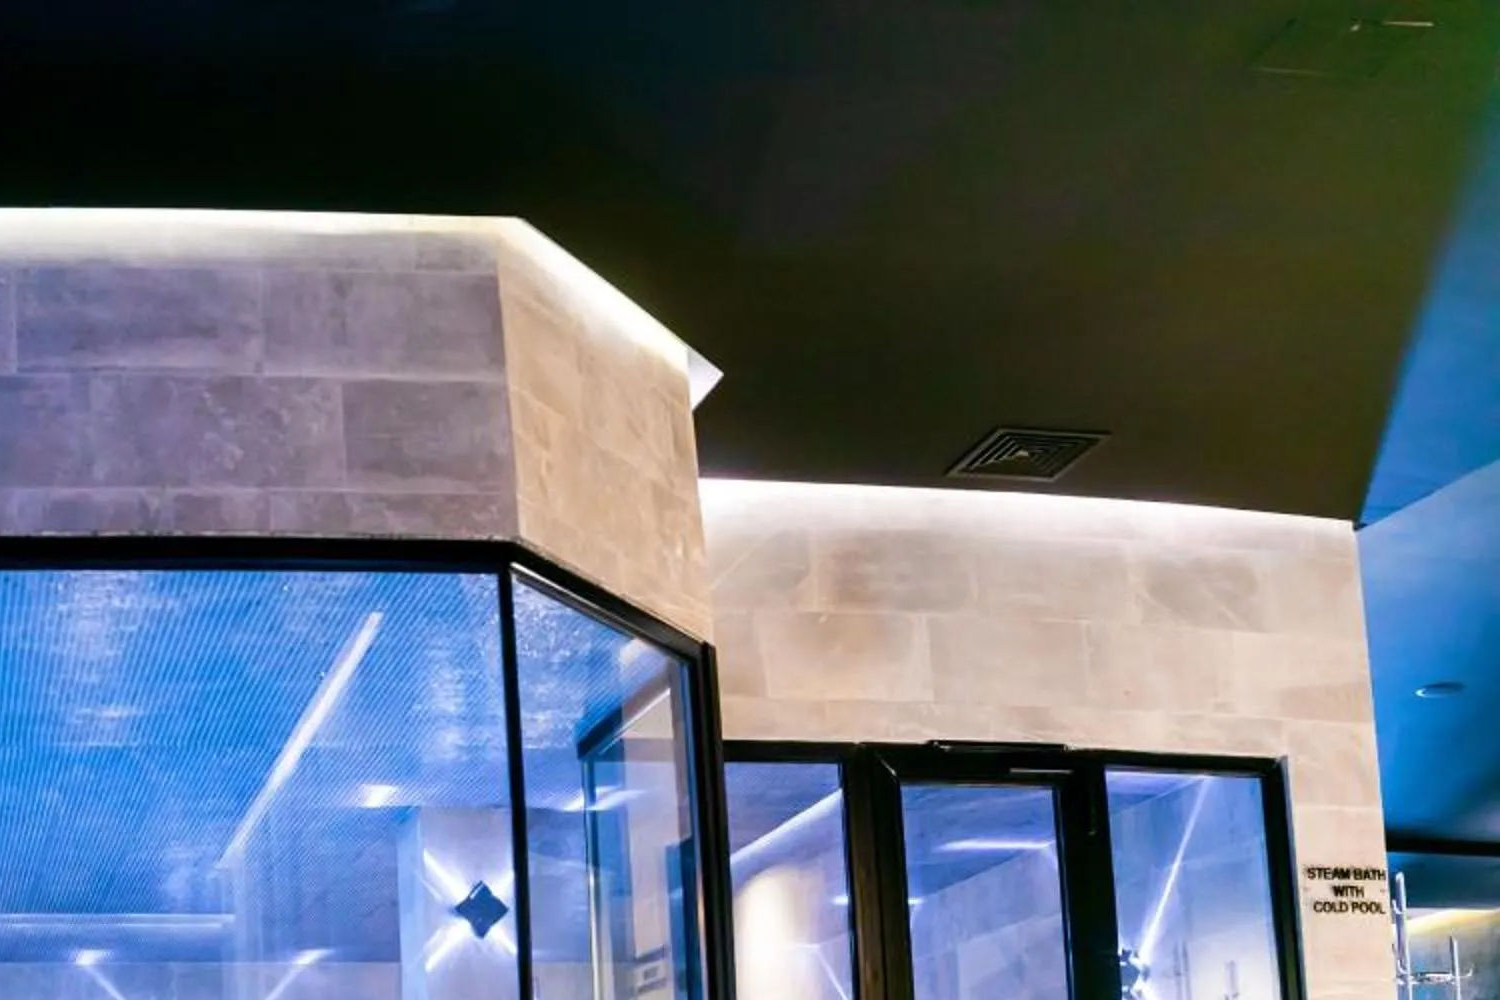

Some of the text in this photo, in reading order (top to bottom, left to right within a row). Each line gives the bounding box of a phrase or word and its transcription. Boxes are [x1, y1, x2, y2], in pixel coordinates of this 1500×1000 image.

[1307, 867, 1386, 881] STEAM BATH
[1332, 884, 1365, 898] WITH
[1312, 901, 1387, 914] COLD POOL
